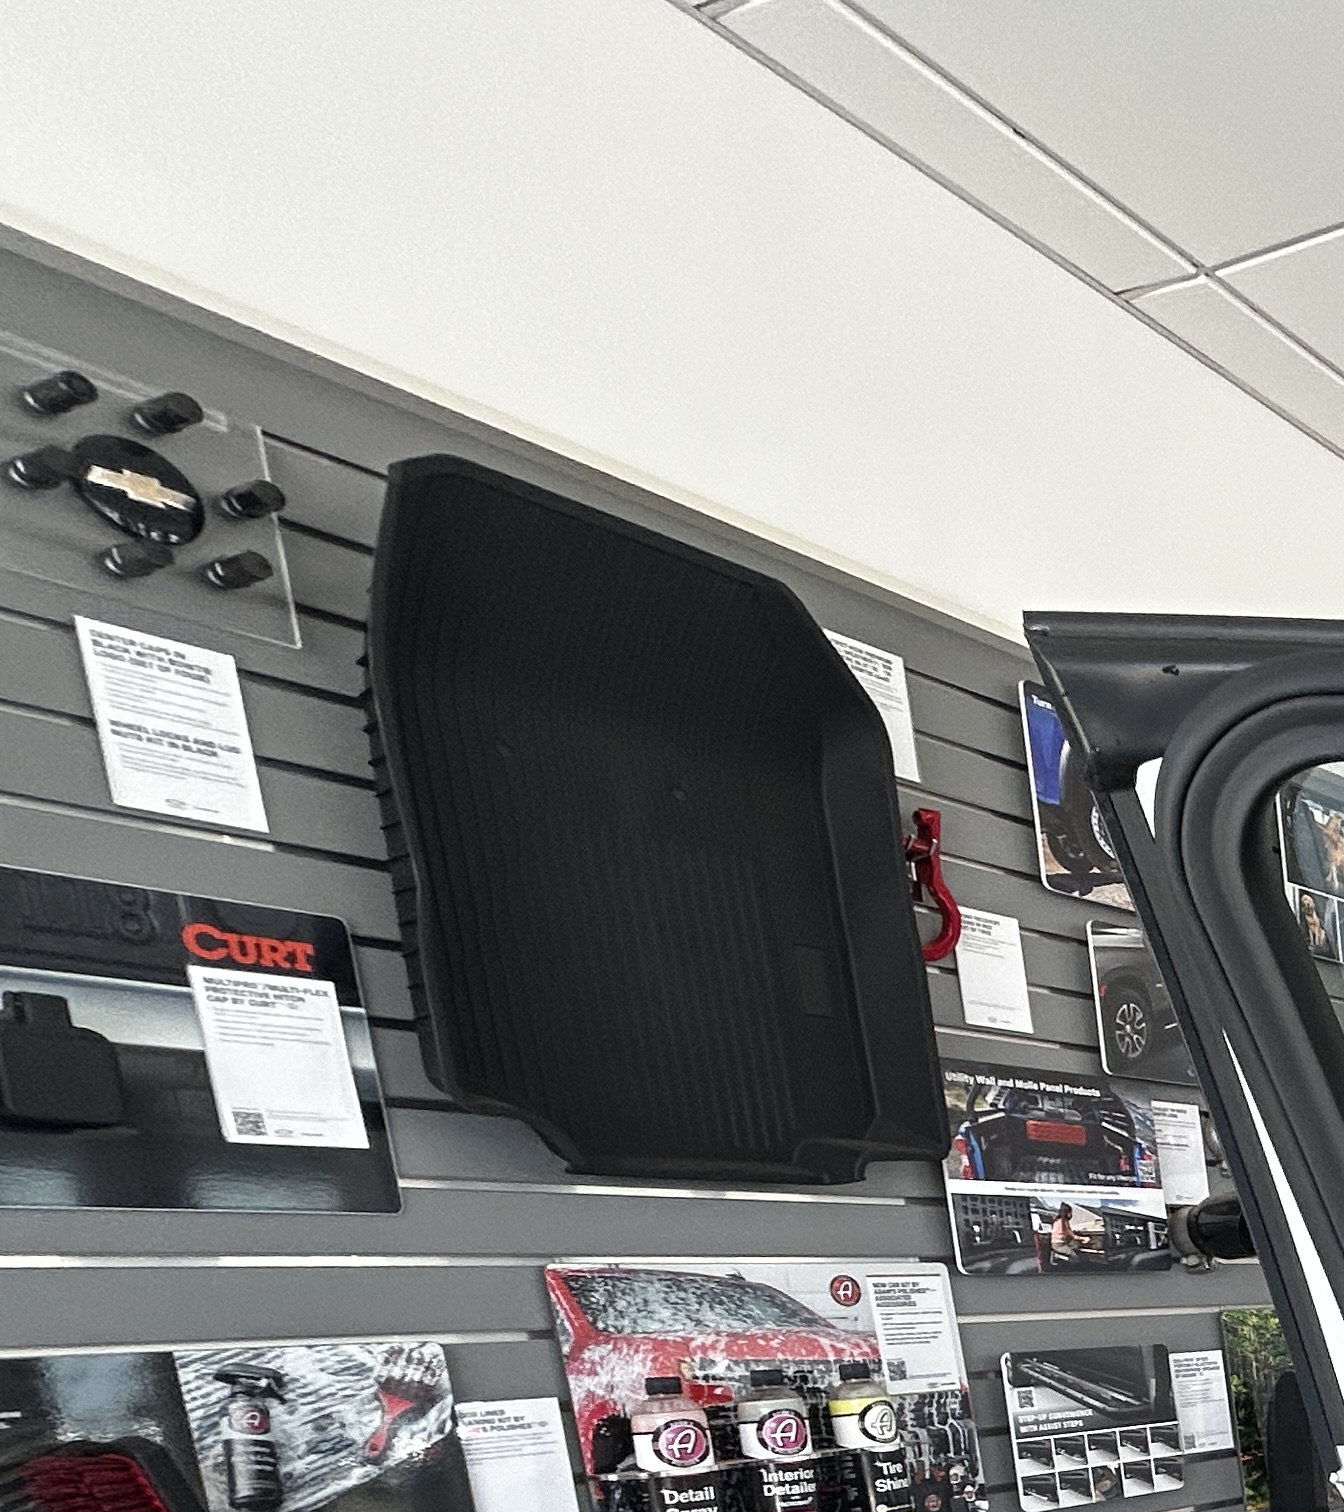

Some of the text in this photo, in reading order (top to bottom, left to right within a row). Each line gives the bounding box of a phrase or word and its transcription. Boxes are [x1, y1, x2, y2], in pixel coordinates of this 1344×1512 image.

[182, 922, 315, 972] CURT
[945, 1072, 974, 1085] Utility
[975, 1075, 996, 1086] Wall
[997, 1078, 1014, 1087] and
[1039, 1082, 1063, 1093] Panel
[1064, 1085, 1101, 1097] Products
[880, 1461, 903, 1476] Tire
[661, 1486, 715, 1505] Detail
